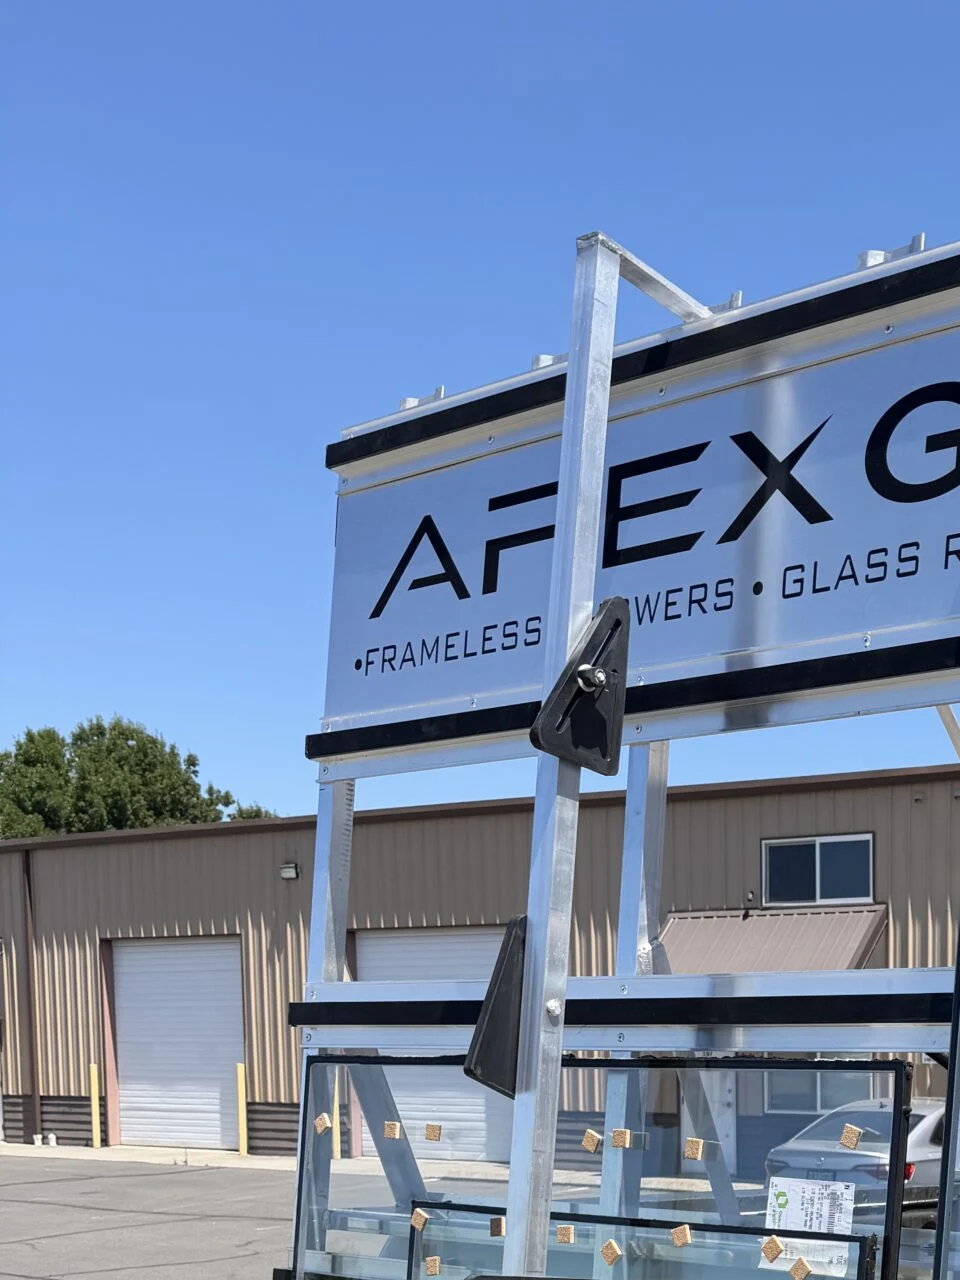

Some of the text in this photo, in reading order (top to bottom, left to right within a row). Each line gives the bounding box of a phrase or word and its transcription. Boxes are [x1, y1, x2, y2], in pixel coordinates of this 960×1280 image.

[365, 616, 541, 676] FRAMELESS
[626, 578, 734, 626] WERS
[782, 541, 920, 599] GLASS
